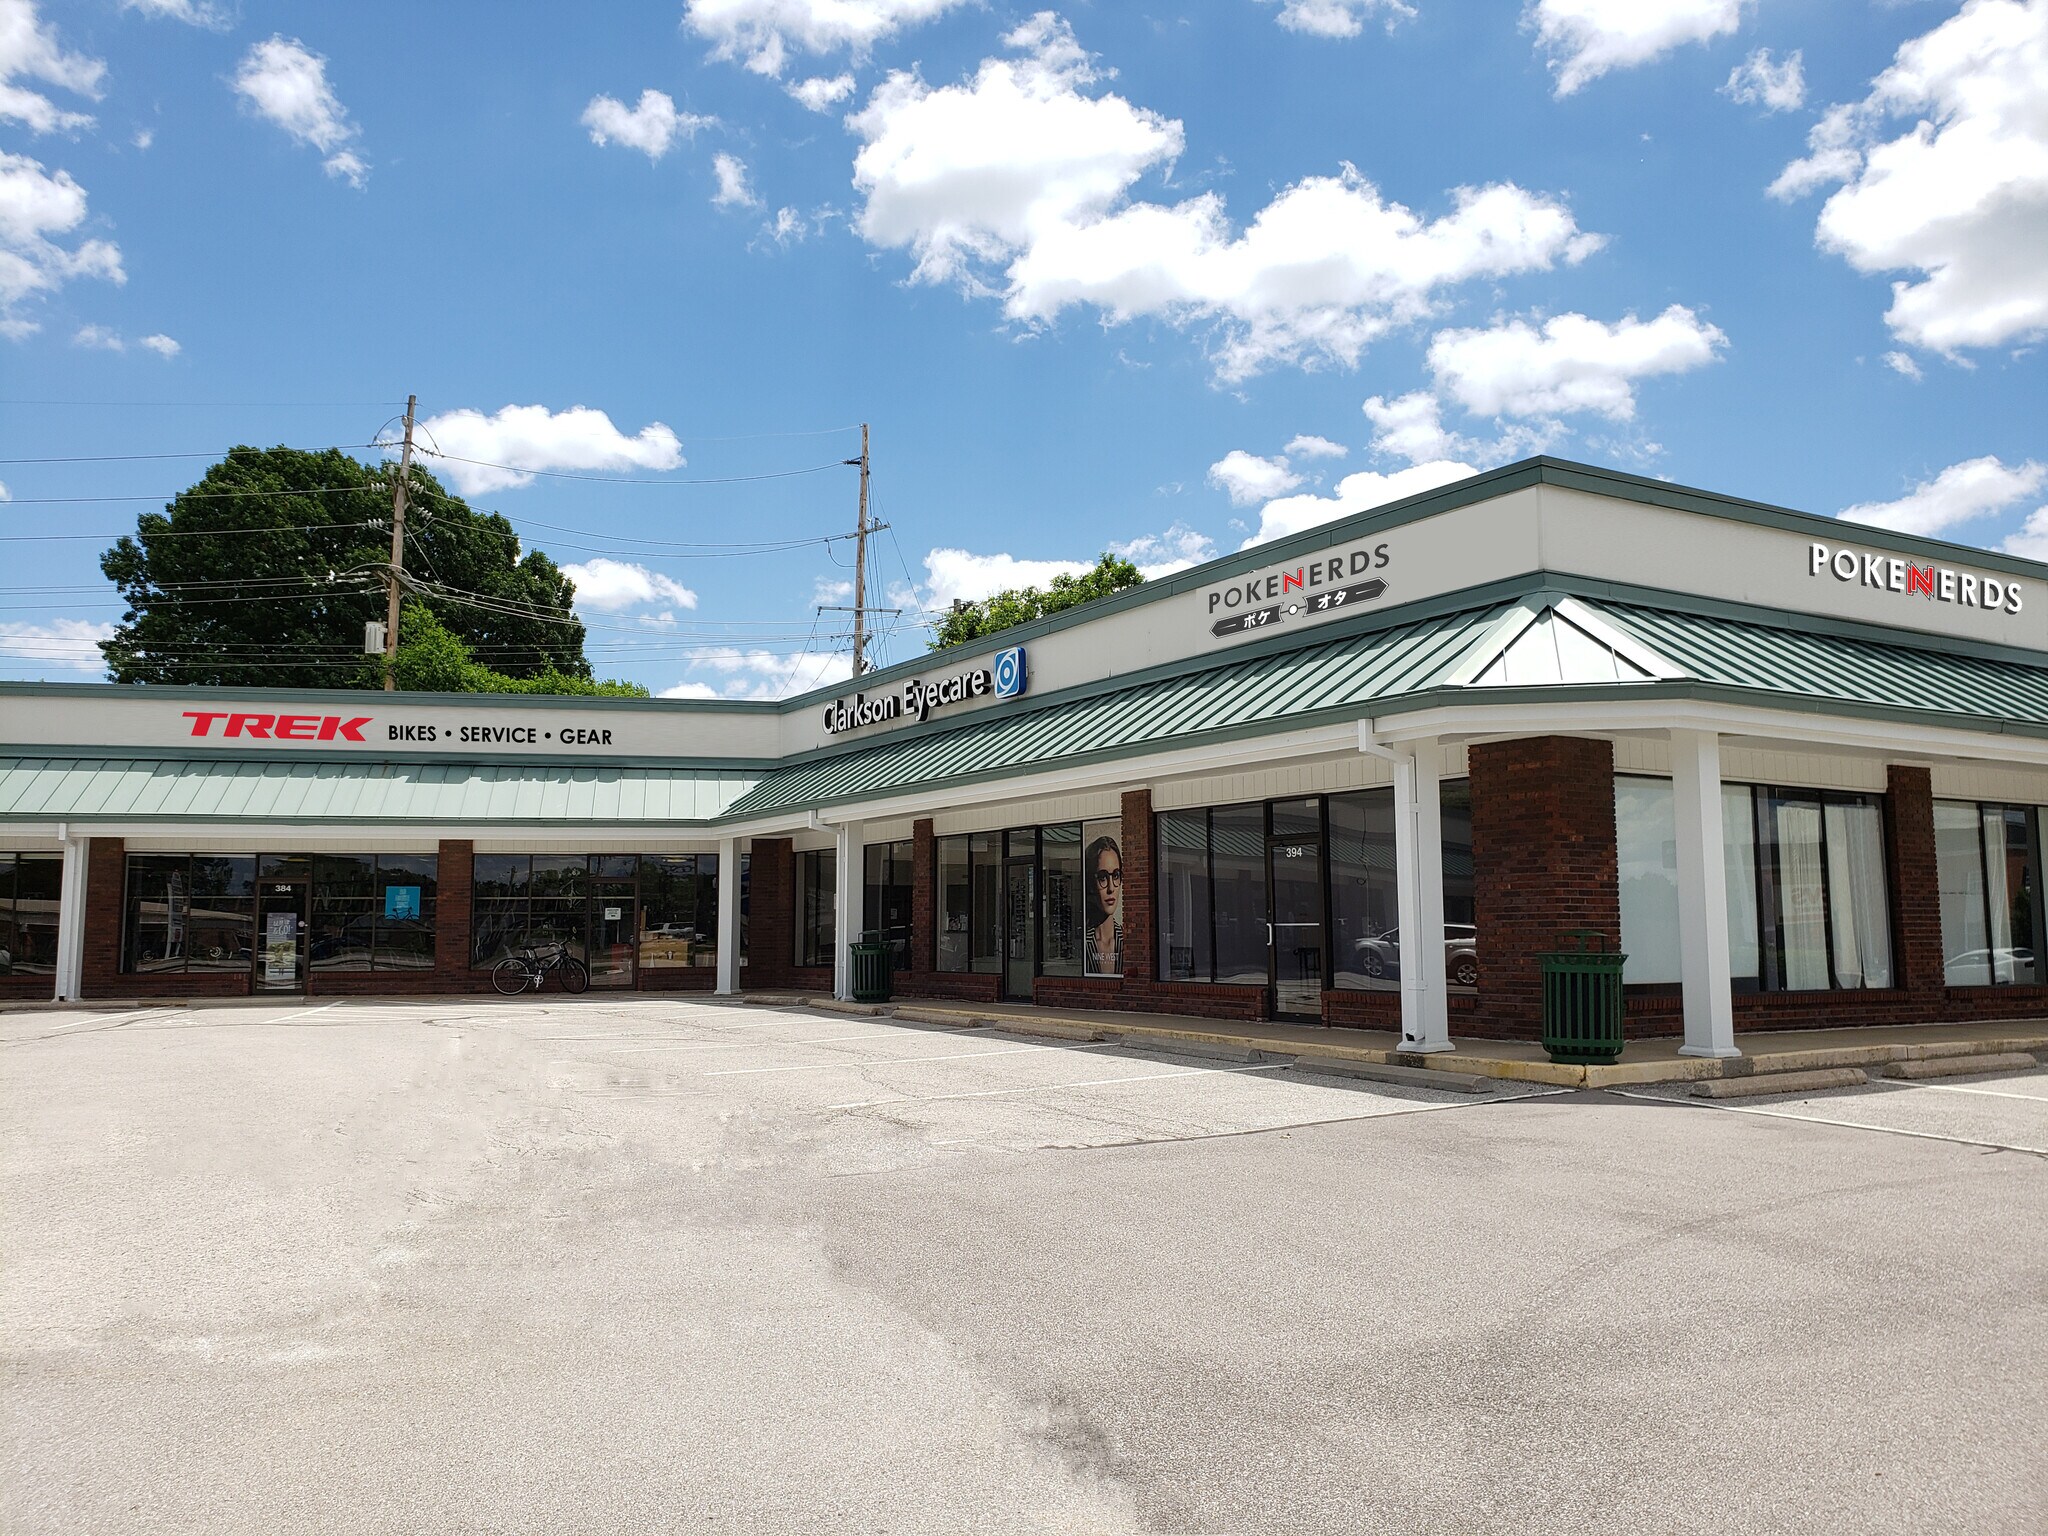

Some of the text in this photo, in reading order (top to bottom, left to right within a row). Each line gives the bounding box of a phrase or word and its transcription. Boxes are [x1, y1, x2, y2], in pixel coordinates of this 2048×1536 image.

[1208, 543, 1390, 614] POKENERDS
[1809, 542, 2023, 615] POKENERDS
[1243, 590, 1347, 629] ポケ オタ
[822, 669, 990, 735] Clarkson Eyecare
[182, 711, 375, 742] TREK
[388, 725, 613, 745] BIKES SERVICE GEAR
[1286, 847, 1303, 858] 394
[275, 884, 292, 892] 384
